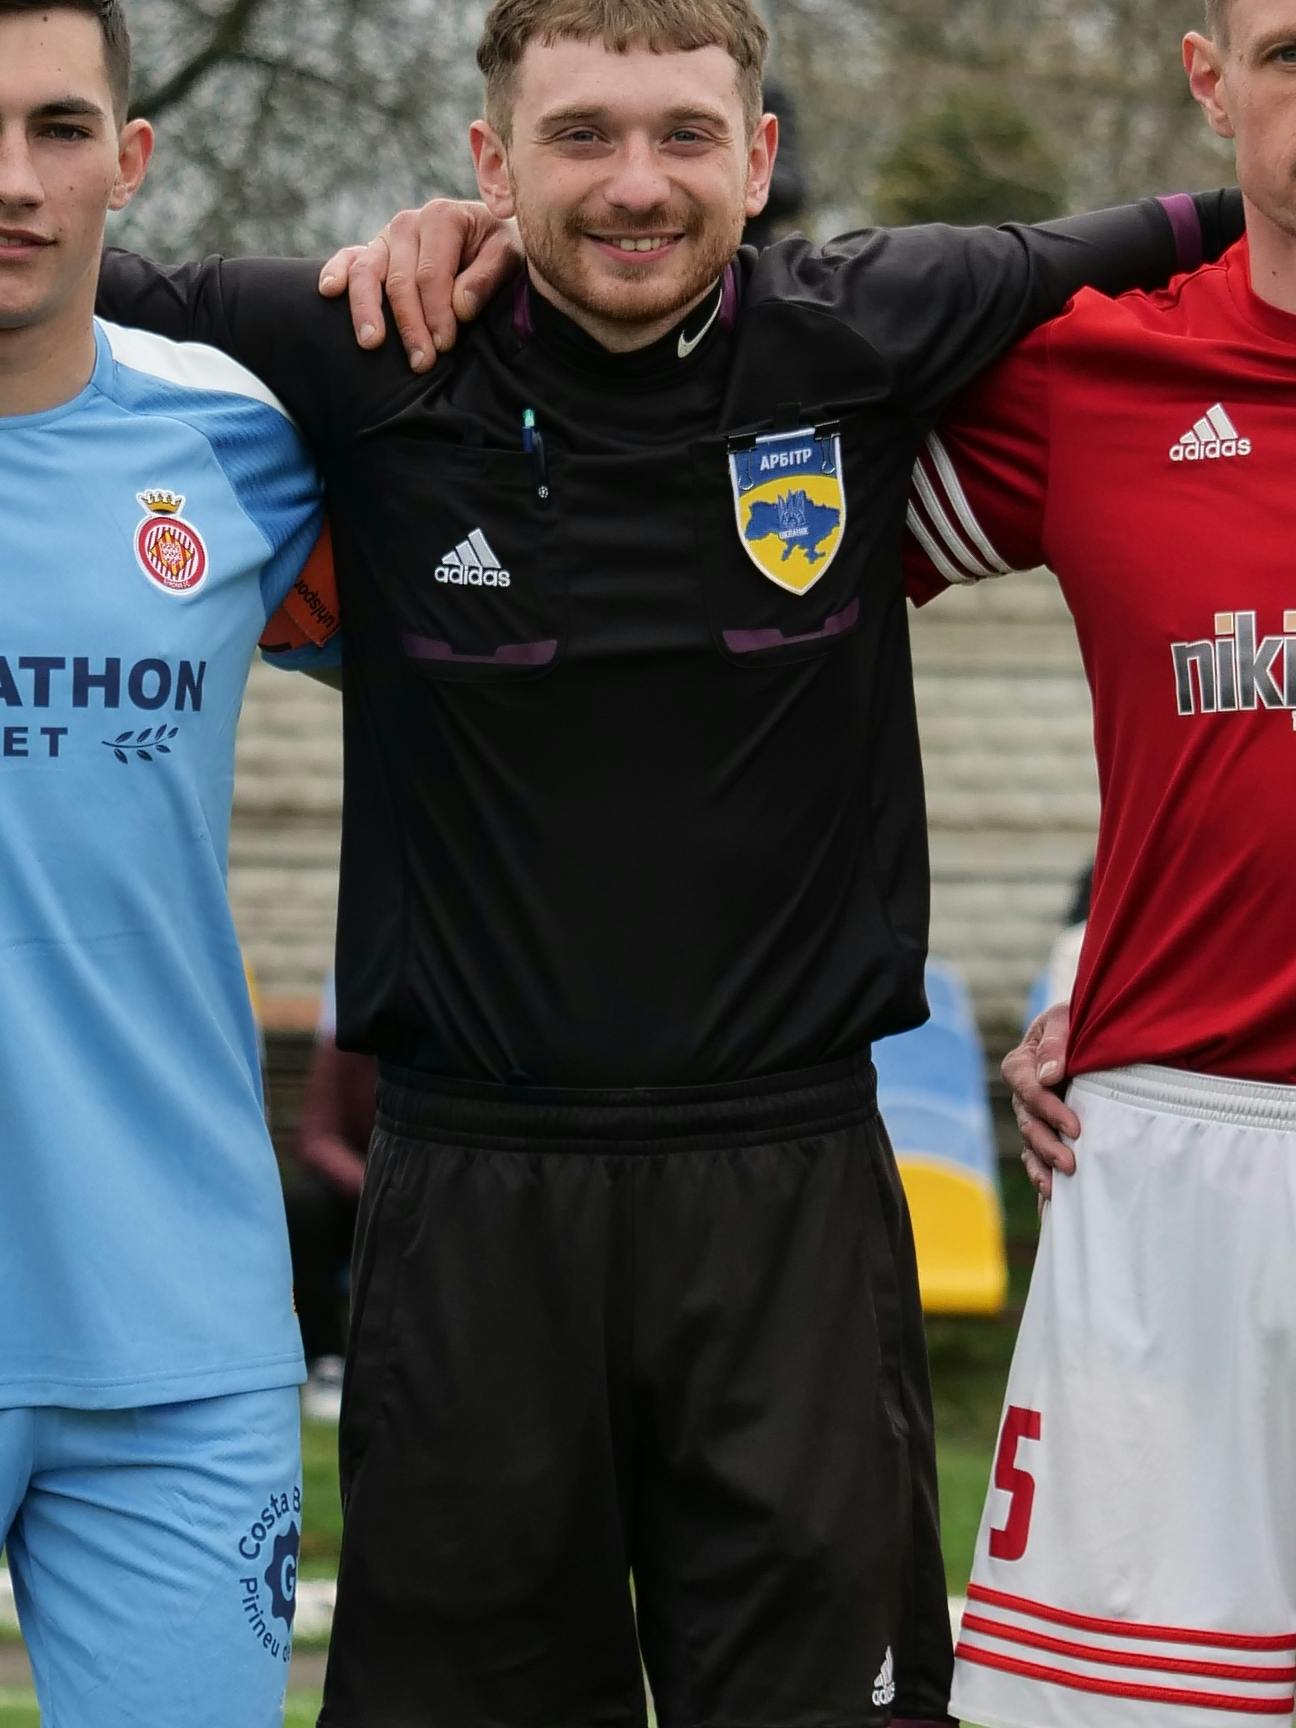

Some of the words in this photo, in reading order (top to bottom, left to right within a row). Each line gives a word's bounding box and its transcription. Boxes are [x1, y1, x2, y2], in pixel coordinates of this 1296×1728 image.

[760, 448, 813, 472] АРБІТР
[1169, 436, 1252, 461] adidas
[434, 565, 511, 587] adidas
[989, 1405, 1041, 1561] 5
[238, 1492, 290, 1560] Costa
[240, 1577, 280, 1659] Pirineu
